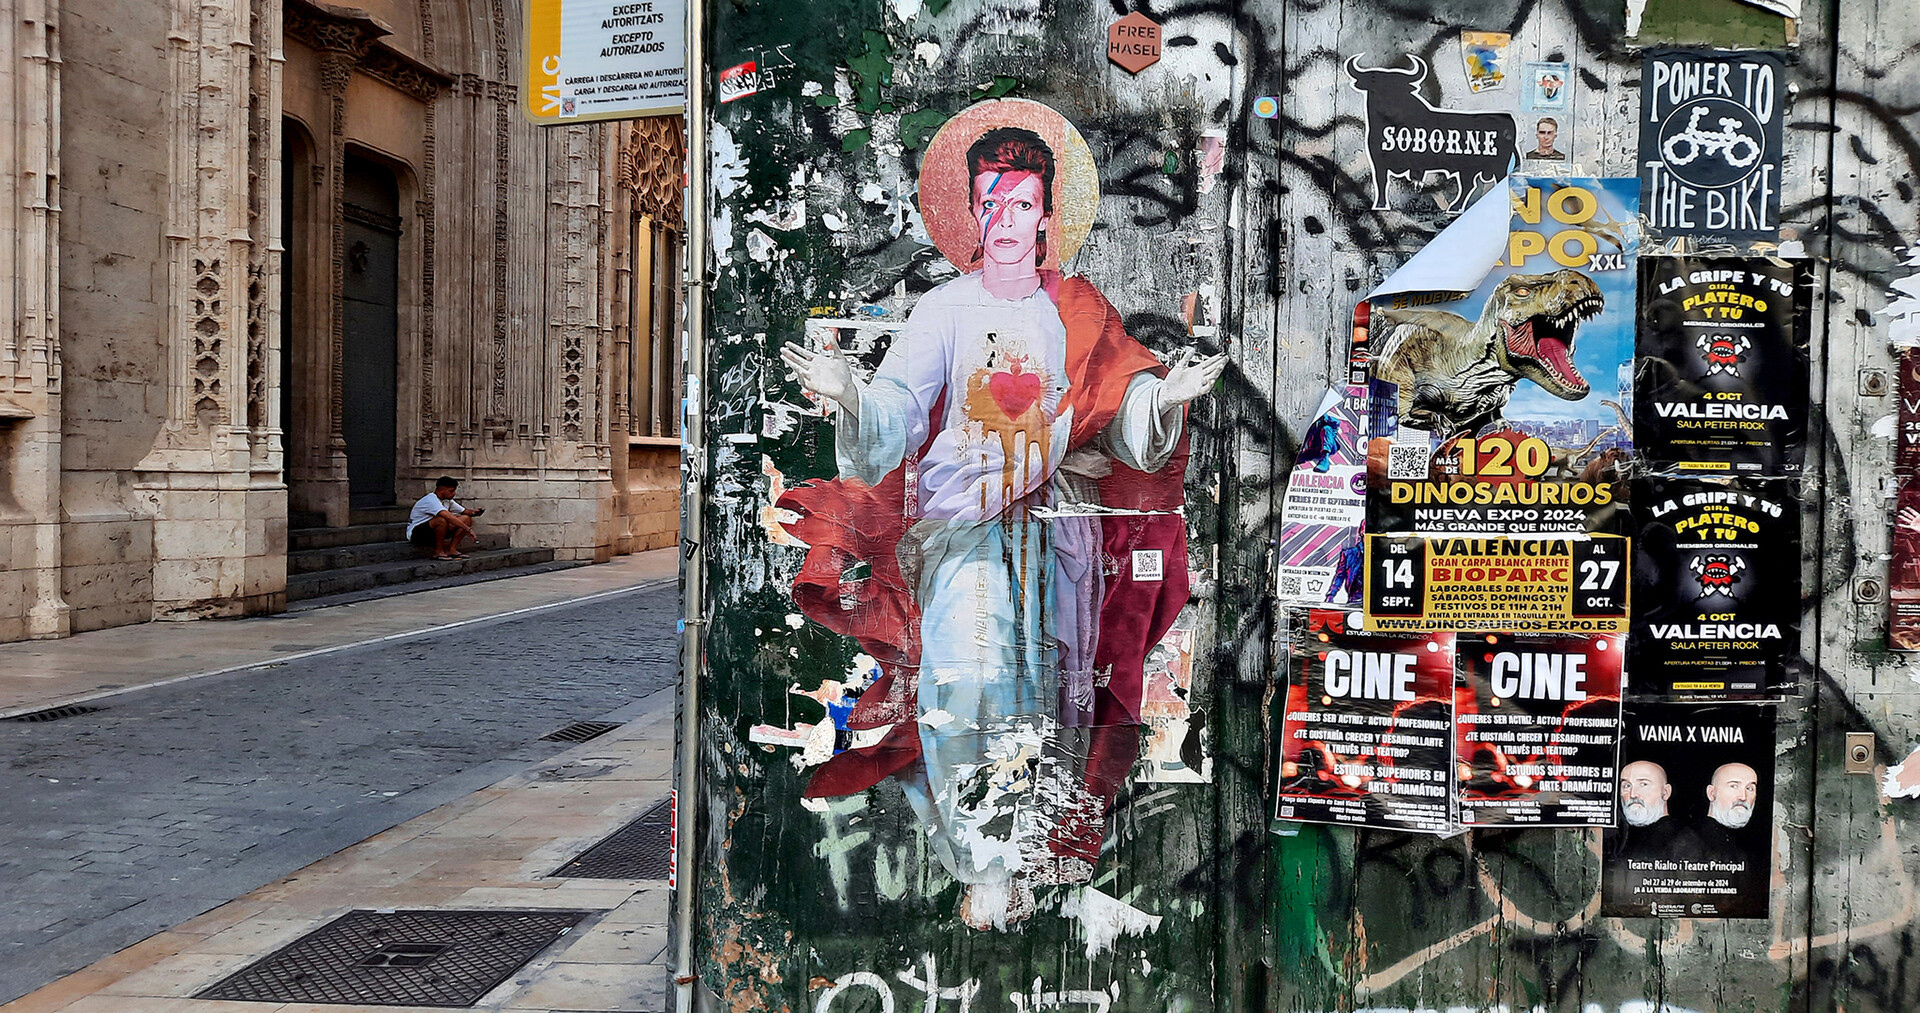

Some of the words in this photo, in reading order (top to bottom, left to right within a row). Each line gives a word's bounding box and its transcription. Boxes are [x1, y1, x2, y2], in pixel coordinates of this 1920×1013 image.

[613, 2, 652, 16] EXCEPTE
[601, 13, 663, 29] AUTORITZATS
[612, 31, 653, 44] EXCEPTO
[1118, 25, 1155, 38] FREE
[600, 42, 665, 58] AUTORIZADOS
[1111, 42, 1159, 56] HASEL
[565, 76, 594, 84] CÀRREGA
[600, 72, 641, 82] DESCÀRREGA
[574, 87, 595, 95] CARGA
[603, 83, 637, 93] DESCARGA
[1650, 61, 1733, 122] POWER
[1740, 63, 1774, 125] TO
[1381, 126, 1498, 156] SOBORNE
[1645, 161, 1697, 229] THE
[1706, 163, 1775, 231] BIKE
[1493, 230, 1598, 267] PO
[1588, 253, 1626, 272] XXL
[1659, 277, 1686, 295] LA
[1689, 270, 1745, 284] GRIPE
[1751, 273, 1766, 286] Y
[1769, 278, 1794, 297] TÚ
[1392, 297, 1408, 310] SE
[1682, 292, 1768, 312] PLATERO
[1703, 307, 1714, 319] Y
[1719, 306, 1743, 320] TÚ
[1703, 392, 1713, 400] 4
[1716, 392, 1742, 401] OCT
[1654, 402, 1788, 420] VALENCIA
[1676, 420, 1702, 429] SALA
[1704, 421, 1737, 430] PETER
[1739, 422, 1765, 430] ROCK
[1436, 455, 1458, 466] MÁS
[1456, 438, 1550, 476] 120
[1445, 466, 1458, 474] DE
[1292, 474, 1344, 489] VALENCIA
[1391, 482, 1613, 505] DINOSAURIOS
[1651, 500, 1678, 518] LA
[1683, 491, 1737, 507] GRIPE
[1743, 494, 1757, 508] Y
[1760, 500, 1782, 518] TÚ
[1415, 509, 1484, 521] NUEVA
[1487, 509, 1539, 521] EXPO
[1543, 509, 1586, 521] 2024
[1415, 521, 1444, 531] MÁS
[1447, 523, 1505, 531] GRANDE
[1507, 523, 1536, 532] QUE
[1540, 523, 1586, 531] NUNCA
[1675, 513, 1760, 535] PLATERO
[1697, 529, 1709, 541] Y
[1714, 527, 1737, 541] TÚ
[1391, 544, 1407, 554] DEL
[1430, 539, 1570, 556] VALENCIA
[1593, 544, 1605, 554] AL
[1431, 558, 1458, 567] GRAN
[1462, 558, 1492, 567] CARPA
[1495, 558, 1532, 567] BLANCA
[1535, 559, 1569, 567] FRENTE
[1382, 559, 1415, 589] 14
[1432, 568, 1569, 582] BIOPARC
[1579, 560, 1620, 590] 27
[1430, 585, 1502, 593] LABORABLES
[1505, 585, 1520, 593] DE
[1523, 585, 1535, 593] 17
[1537, 585, 1545, 593] A
[1548, 585, 1569, 593] 21H
[1382, 597, 1413, 607] SEPT.
[1431, 592, 1488, 602] SÁBADOS,
[1587, 597, 1613, 608] OCT.
[1434, 603, 1491, 611] FESTIVOS
[1493, 603, 1507, 611] DE
[1509, 603, 1528, 611] 11H
[1530, 603, 1539, 611] A
[1541, 603, 1562, 611] 21H
[1710, 613, 1736, 621] OCT
[1376, 619, 1618, 630] WWW.DINOSAURIOS-EXPO.ES
[1649, 624, 1782, 639] VALENCIA
[1732, 641, 1759, 649] ROCK
[1324, 650, 1417, 701] CINE
[1491, 651, 1587, 701] CINE
[1457, 714, 1492, 724] ¿QUIERES
[1494, 715, 1507, 724] SER
[1537, 716, 1561, 726] ACTOR
[1564, 717, 1618, 727] PROFESIONAL?
[1465, 732, 1478, 741] ¿TE
[1480, 731, 1515, 742] GUSTARÍA
[1544, 733, 1549, 742] Y
[1551, 733, 1612, 744] DESARROLLARTE
[1639, 725, 1682, 742] VANIA
[1686, 726, 1697, 742] X
[1700, 727, 1744, 743] VANIA
[1325, 744, 1330, 753] A
[1332, 743, 1359, 755] TRAVÉS
[1361, 745, 1374, 755] DEL
[1376, 747, 1409, 758] TEATRO?
[1496, 746, 1502, 755] A
[1503, 745, 1530, 755] TRAVÉS
[1532, 746, 1544, 755] DEL
[1546, 746, 1578, 756] TEATRO?
[1334, 766, 1375, 777] ESTUDIOS
[1376, 768, 1431, 781] SUPERIORES
[1434, 770, 1445, 782] EN
[1506, 765, 1545, 776] ESTUDIOS
[1547, 766, 1600, 777] SUPERIORES
[1602, 767, 1613, 778] EN
[1368, 782, 1390, 793] ARTE
[1392, 782, 1445, 797] DRAMÁTICO
[1539, 781, 1559, 791] ARTE
[1562, 780, 1612, 793] DRAMÁTICO
[1627, 860, 1653, 871] Teatre
[1654, 860, 1677, 871] Rialto
[1679, 860, 1682, 871] i
[1683, 860, 1708, 871] Teatre
[1710, 861, 1745, 874] Principal
